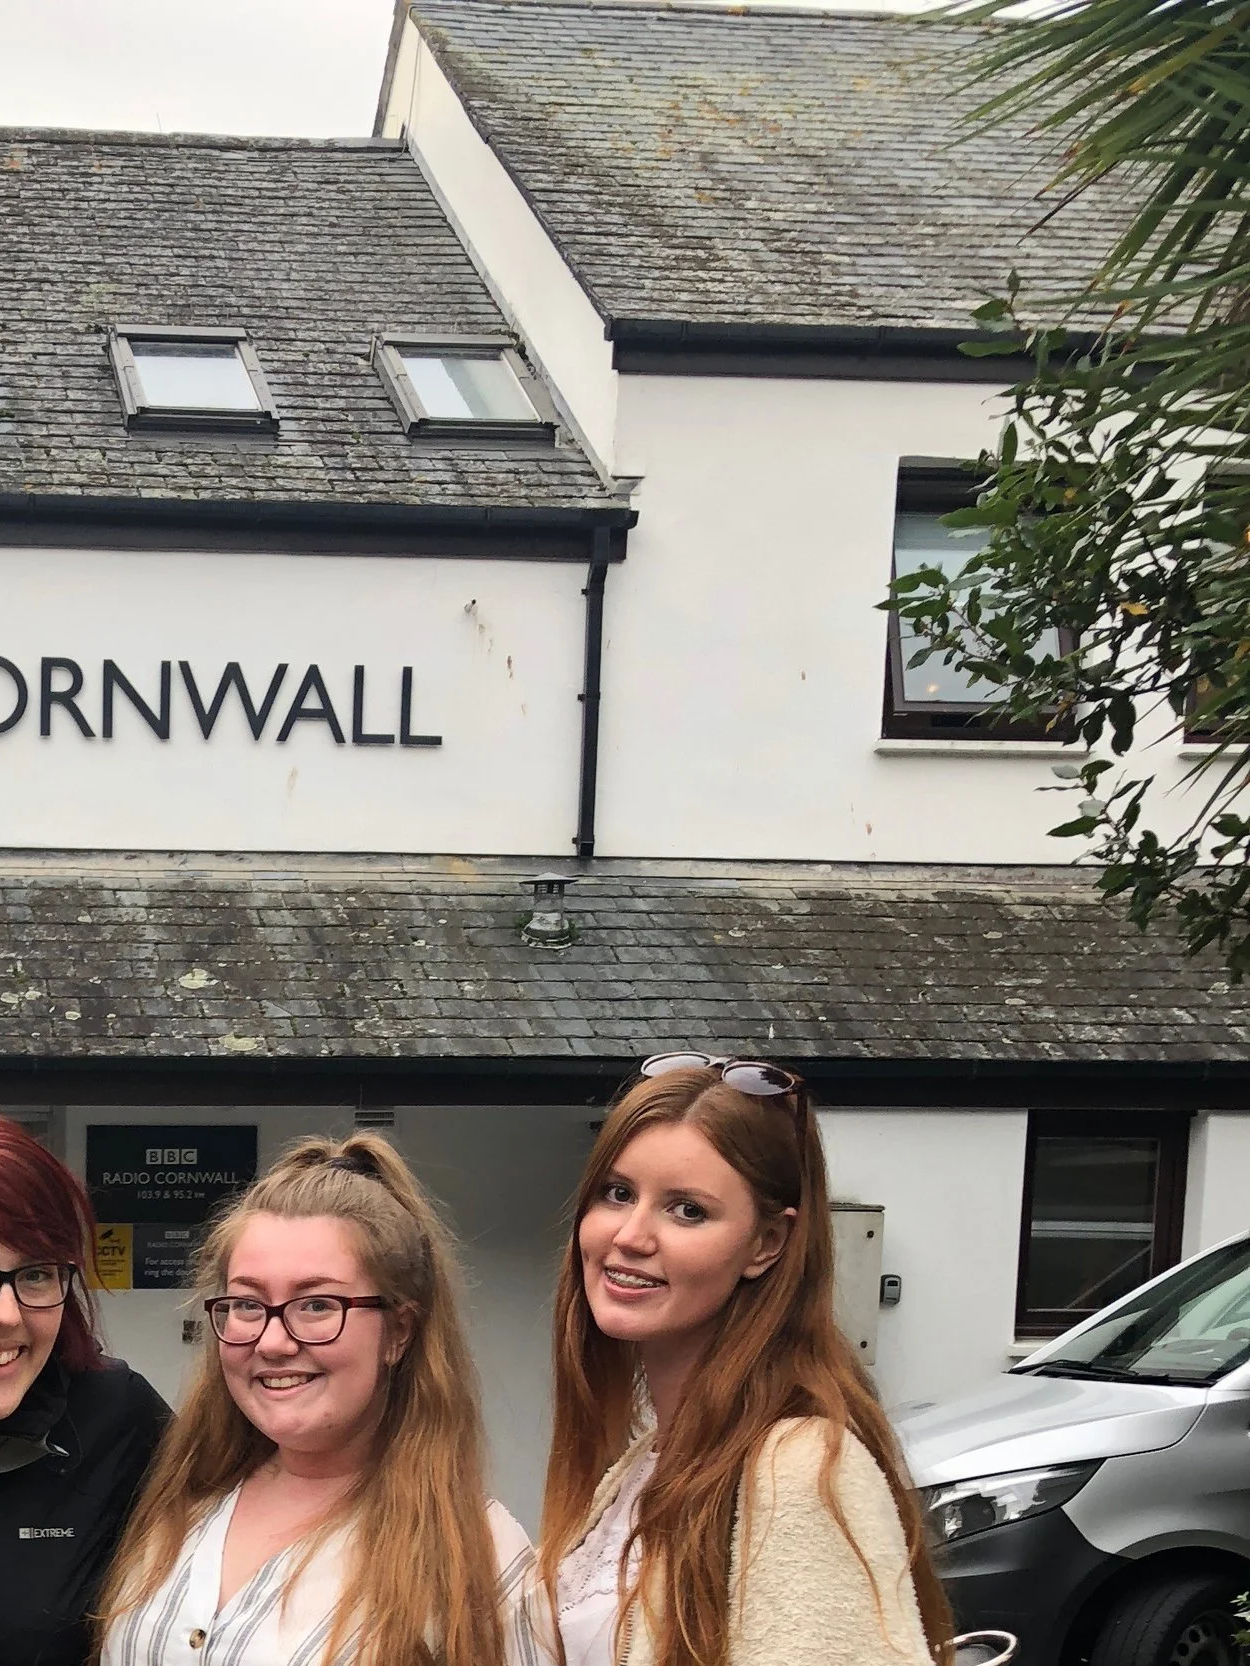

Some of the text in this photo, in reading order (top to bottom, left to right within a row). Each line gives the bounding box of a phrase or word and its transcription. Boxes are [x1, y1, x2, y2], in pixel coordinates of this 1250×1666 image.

[146, 1148, 198, 1165] BBC
[102, 1171, 238, 1185] RADIO CORNWALL
[34, 1527, 75, 1538] EXTREME
